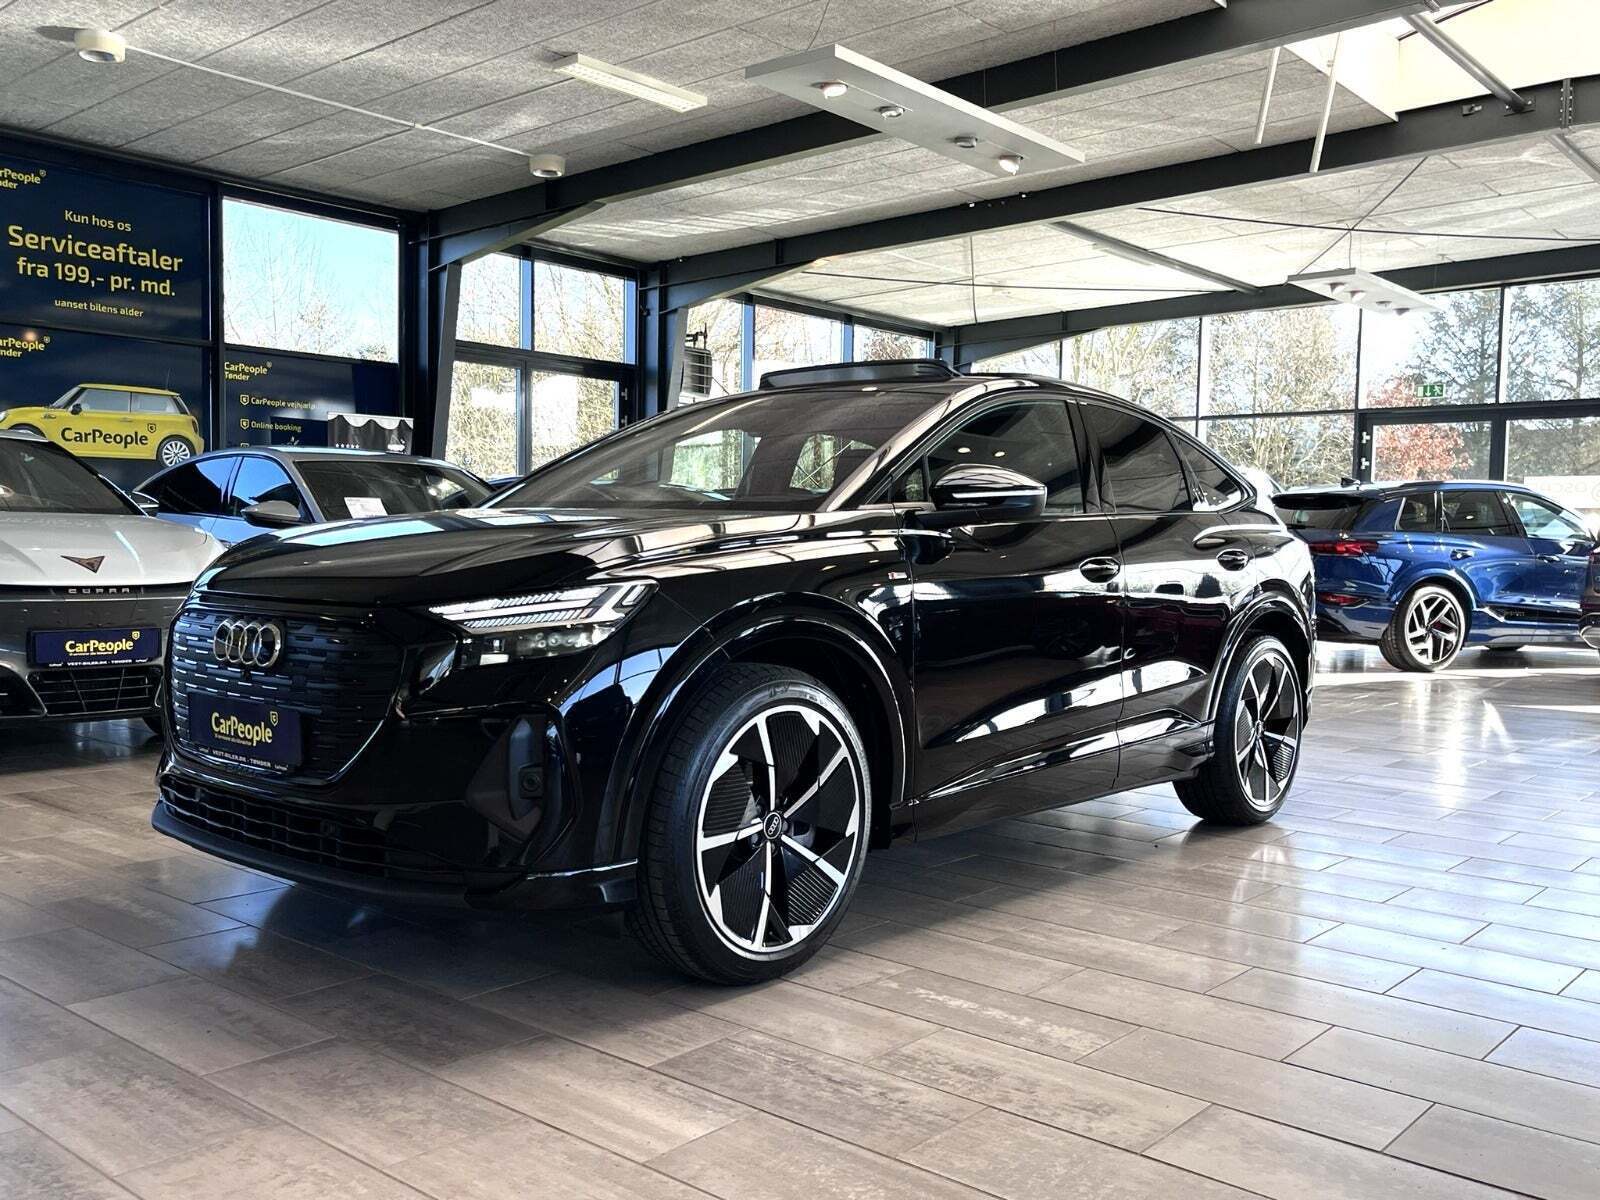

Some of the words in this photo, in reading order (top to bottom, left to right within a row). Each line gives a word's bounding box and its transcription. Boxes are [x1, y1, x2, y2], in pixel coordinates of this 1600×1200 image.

[64, 210, 89, 225] Kun
[92, 214, 114, 230] hos
[117, 221, 132, 232] os
[8, 225, 183, 272] Serviceaftaler
[17, 256, 49, 278] fra
[54, 262, 105, 288] 199,-
[110, 274, 136, 292] pr.
[140, 279, 176, 297] md.
[54, 299, 88, 311] uanset
[90, 303, 118, 315] bilens
[120, 307, 144, 318] alder
[224, 361, 268, 376] CarPeople
[224, 372, 250, 381] Tønder
[251, 397, 286, 408] CarPeople
[251, 421, 274, 430] Online
[275, 424, 302, 433] booking
[60, 427, 149, 449] CarPeople
[65, 638, 134, 655] CarPeople
[211, 712, 273, 747] CarPeople
